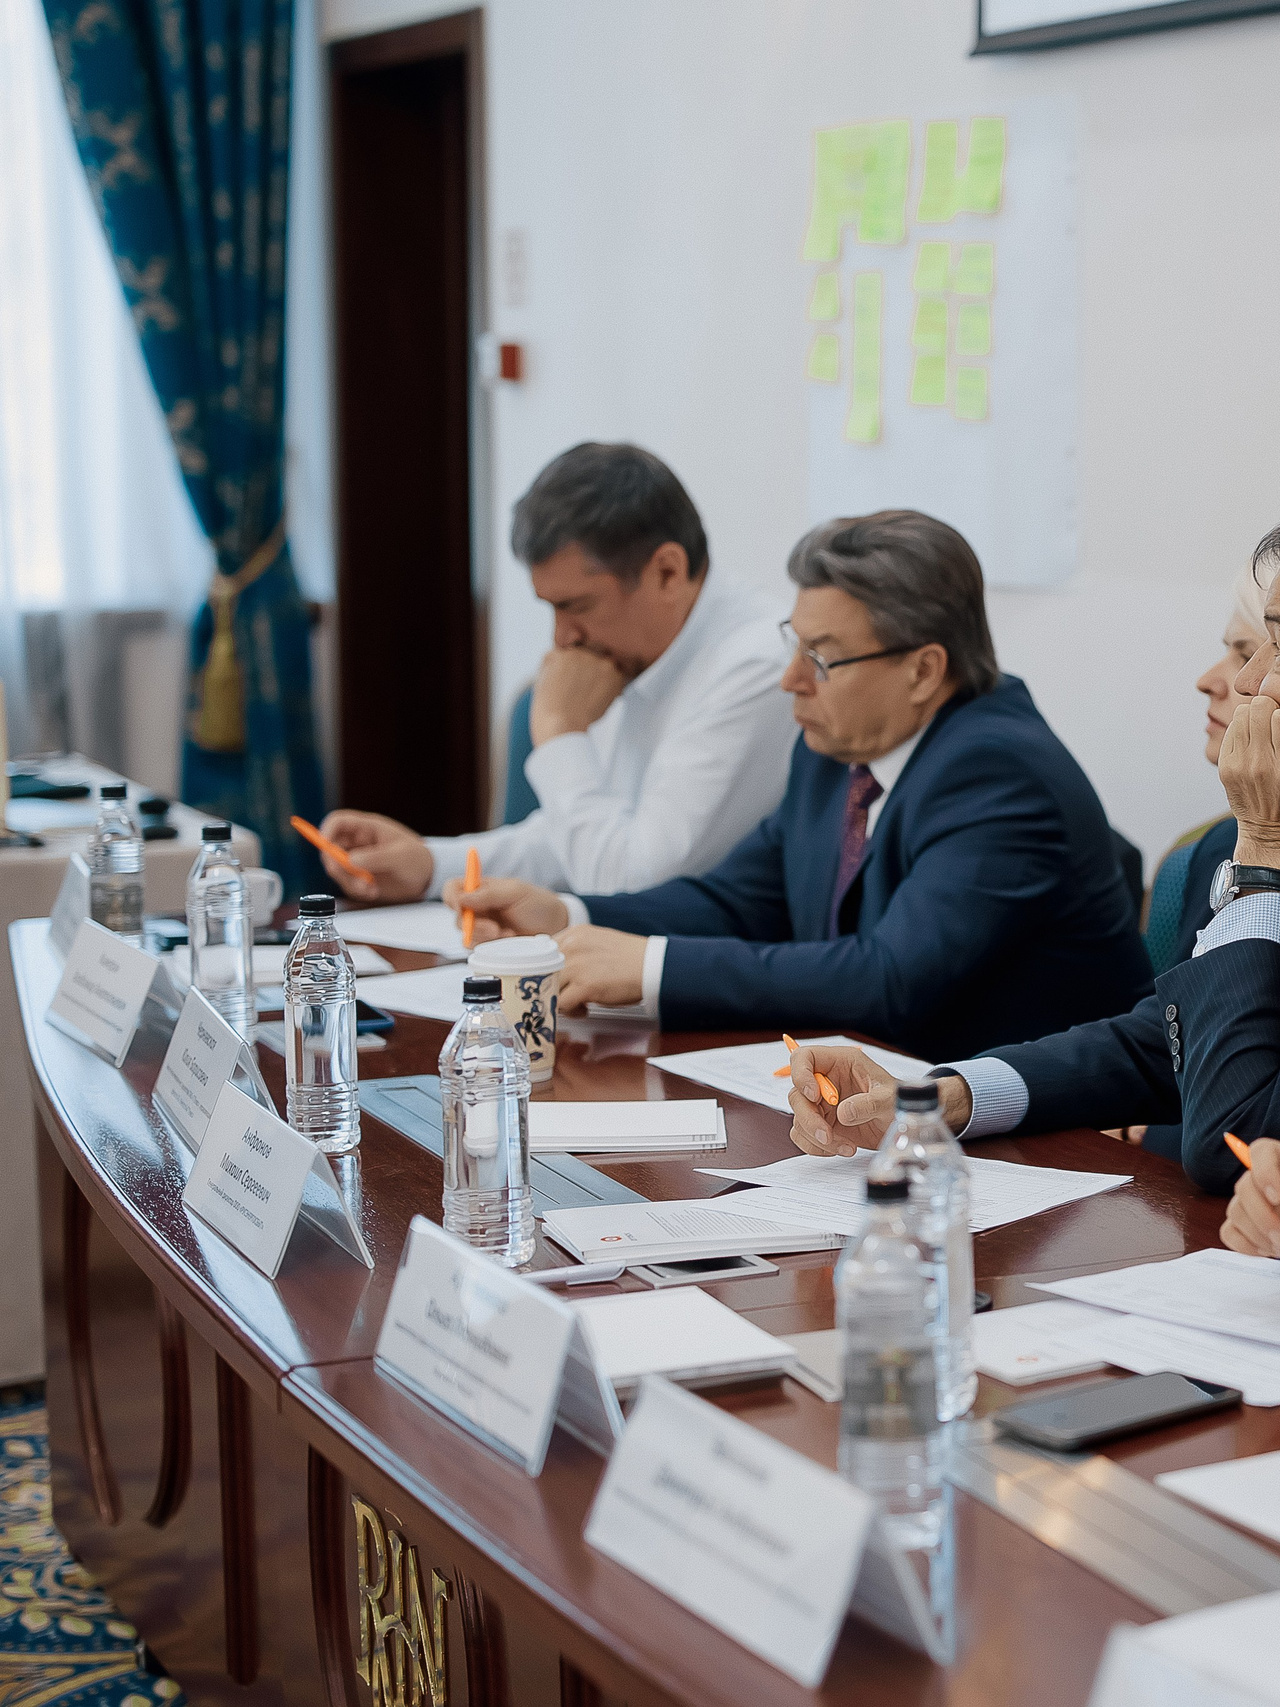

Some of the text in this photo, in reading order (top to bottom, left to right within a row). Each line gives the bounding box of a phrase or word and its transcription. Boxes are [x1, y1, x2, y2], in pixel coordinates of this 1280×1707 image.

[242, 1126, 272, 1159] Андронов
[219, 1152, 271, 1204] Михаил Сергеевич
